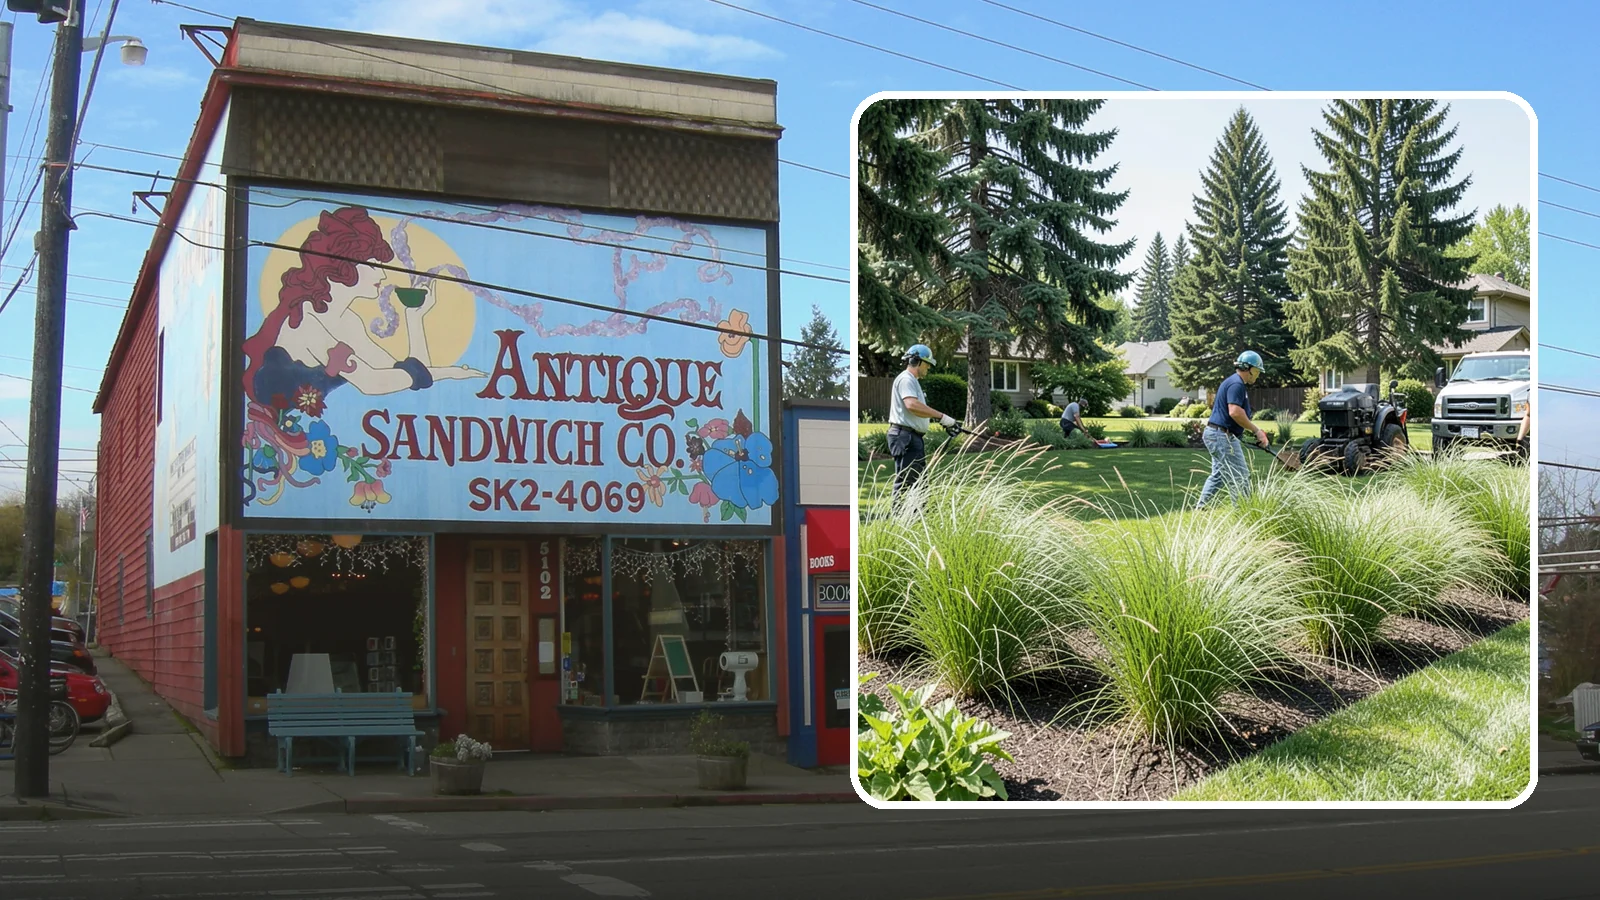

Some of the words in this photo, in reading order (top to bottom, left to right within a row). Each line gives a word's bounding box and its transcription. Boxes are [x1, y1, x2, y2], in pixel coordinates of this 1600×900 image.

[477, 329, 723, 420] ANTIQUE
[361, 408, 605, 467] SANDWICH
[616, 422, 685, 468] CO.
[469, 478, 646, 513] SK2-4069
[809, 555, 835, 569] BOOKS
